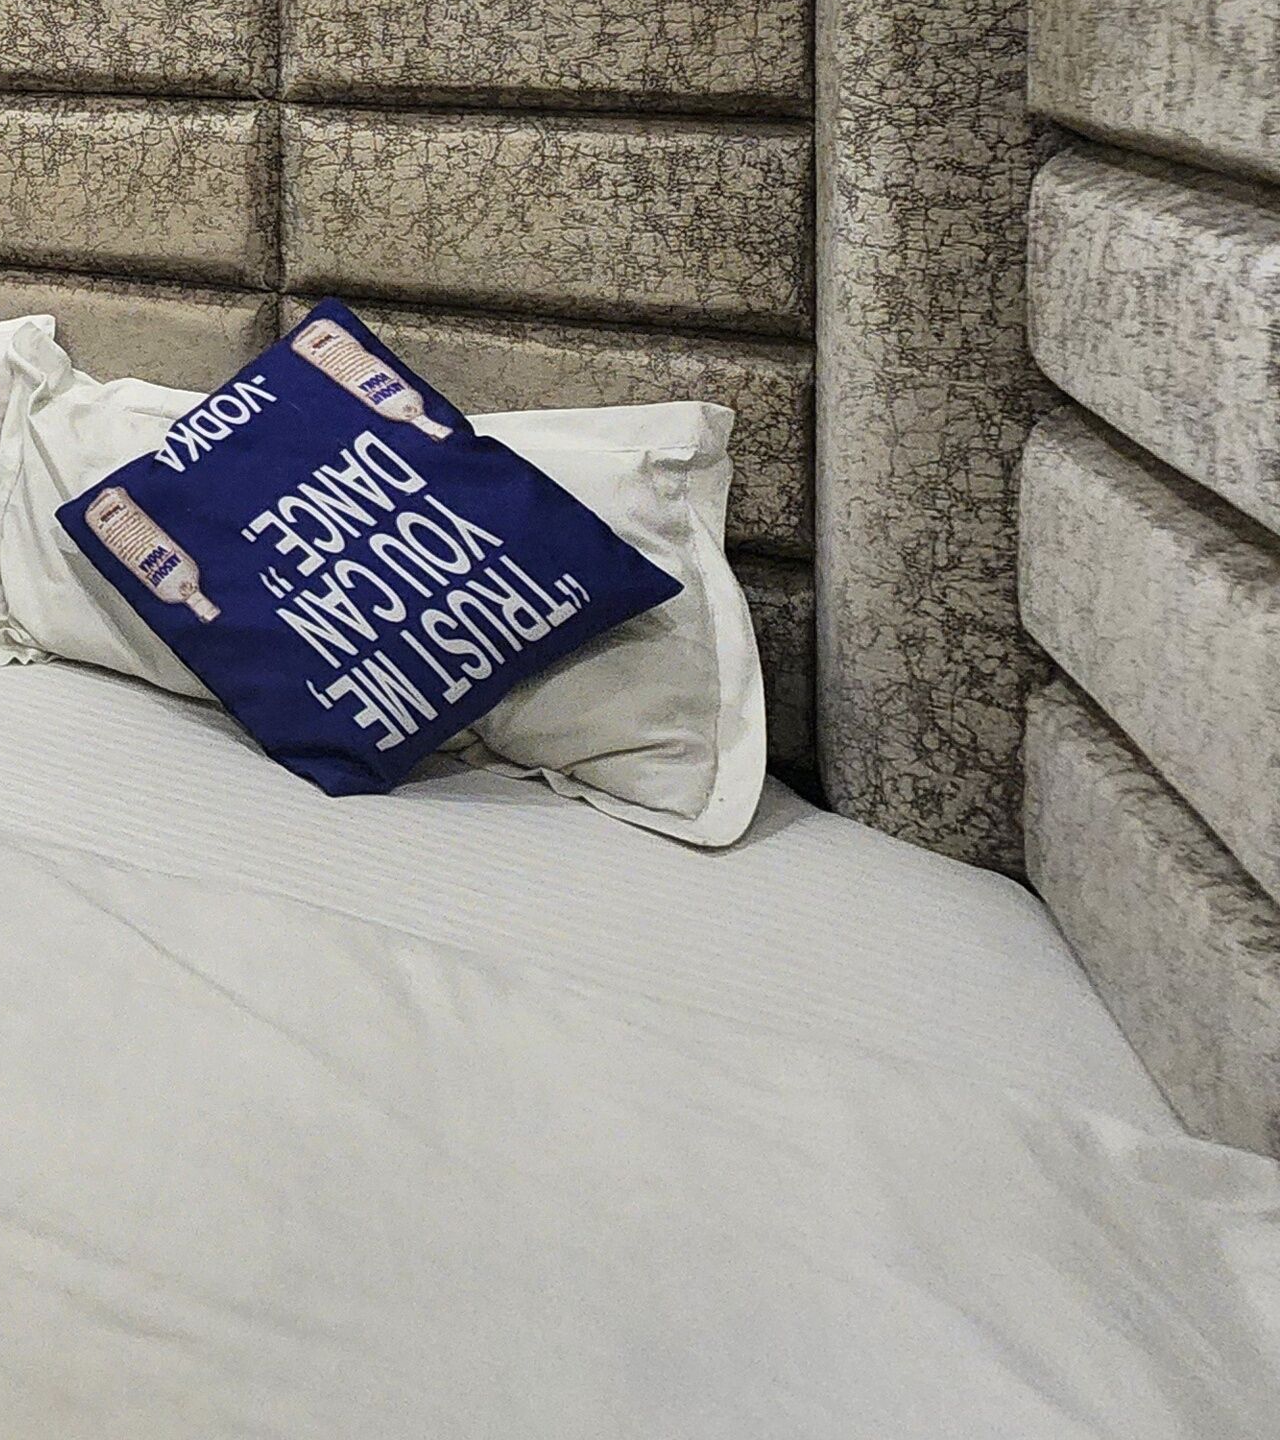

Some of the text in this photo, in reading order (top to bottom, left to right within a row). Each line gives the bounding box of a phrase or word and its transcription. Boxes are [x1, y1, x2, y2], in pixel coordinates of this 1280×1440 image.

[275, 493, 504, 670] YOU CAN
[305, 650, 438, 752] ME,
